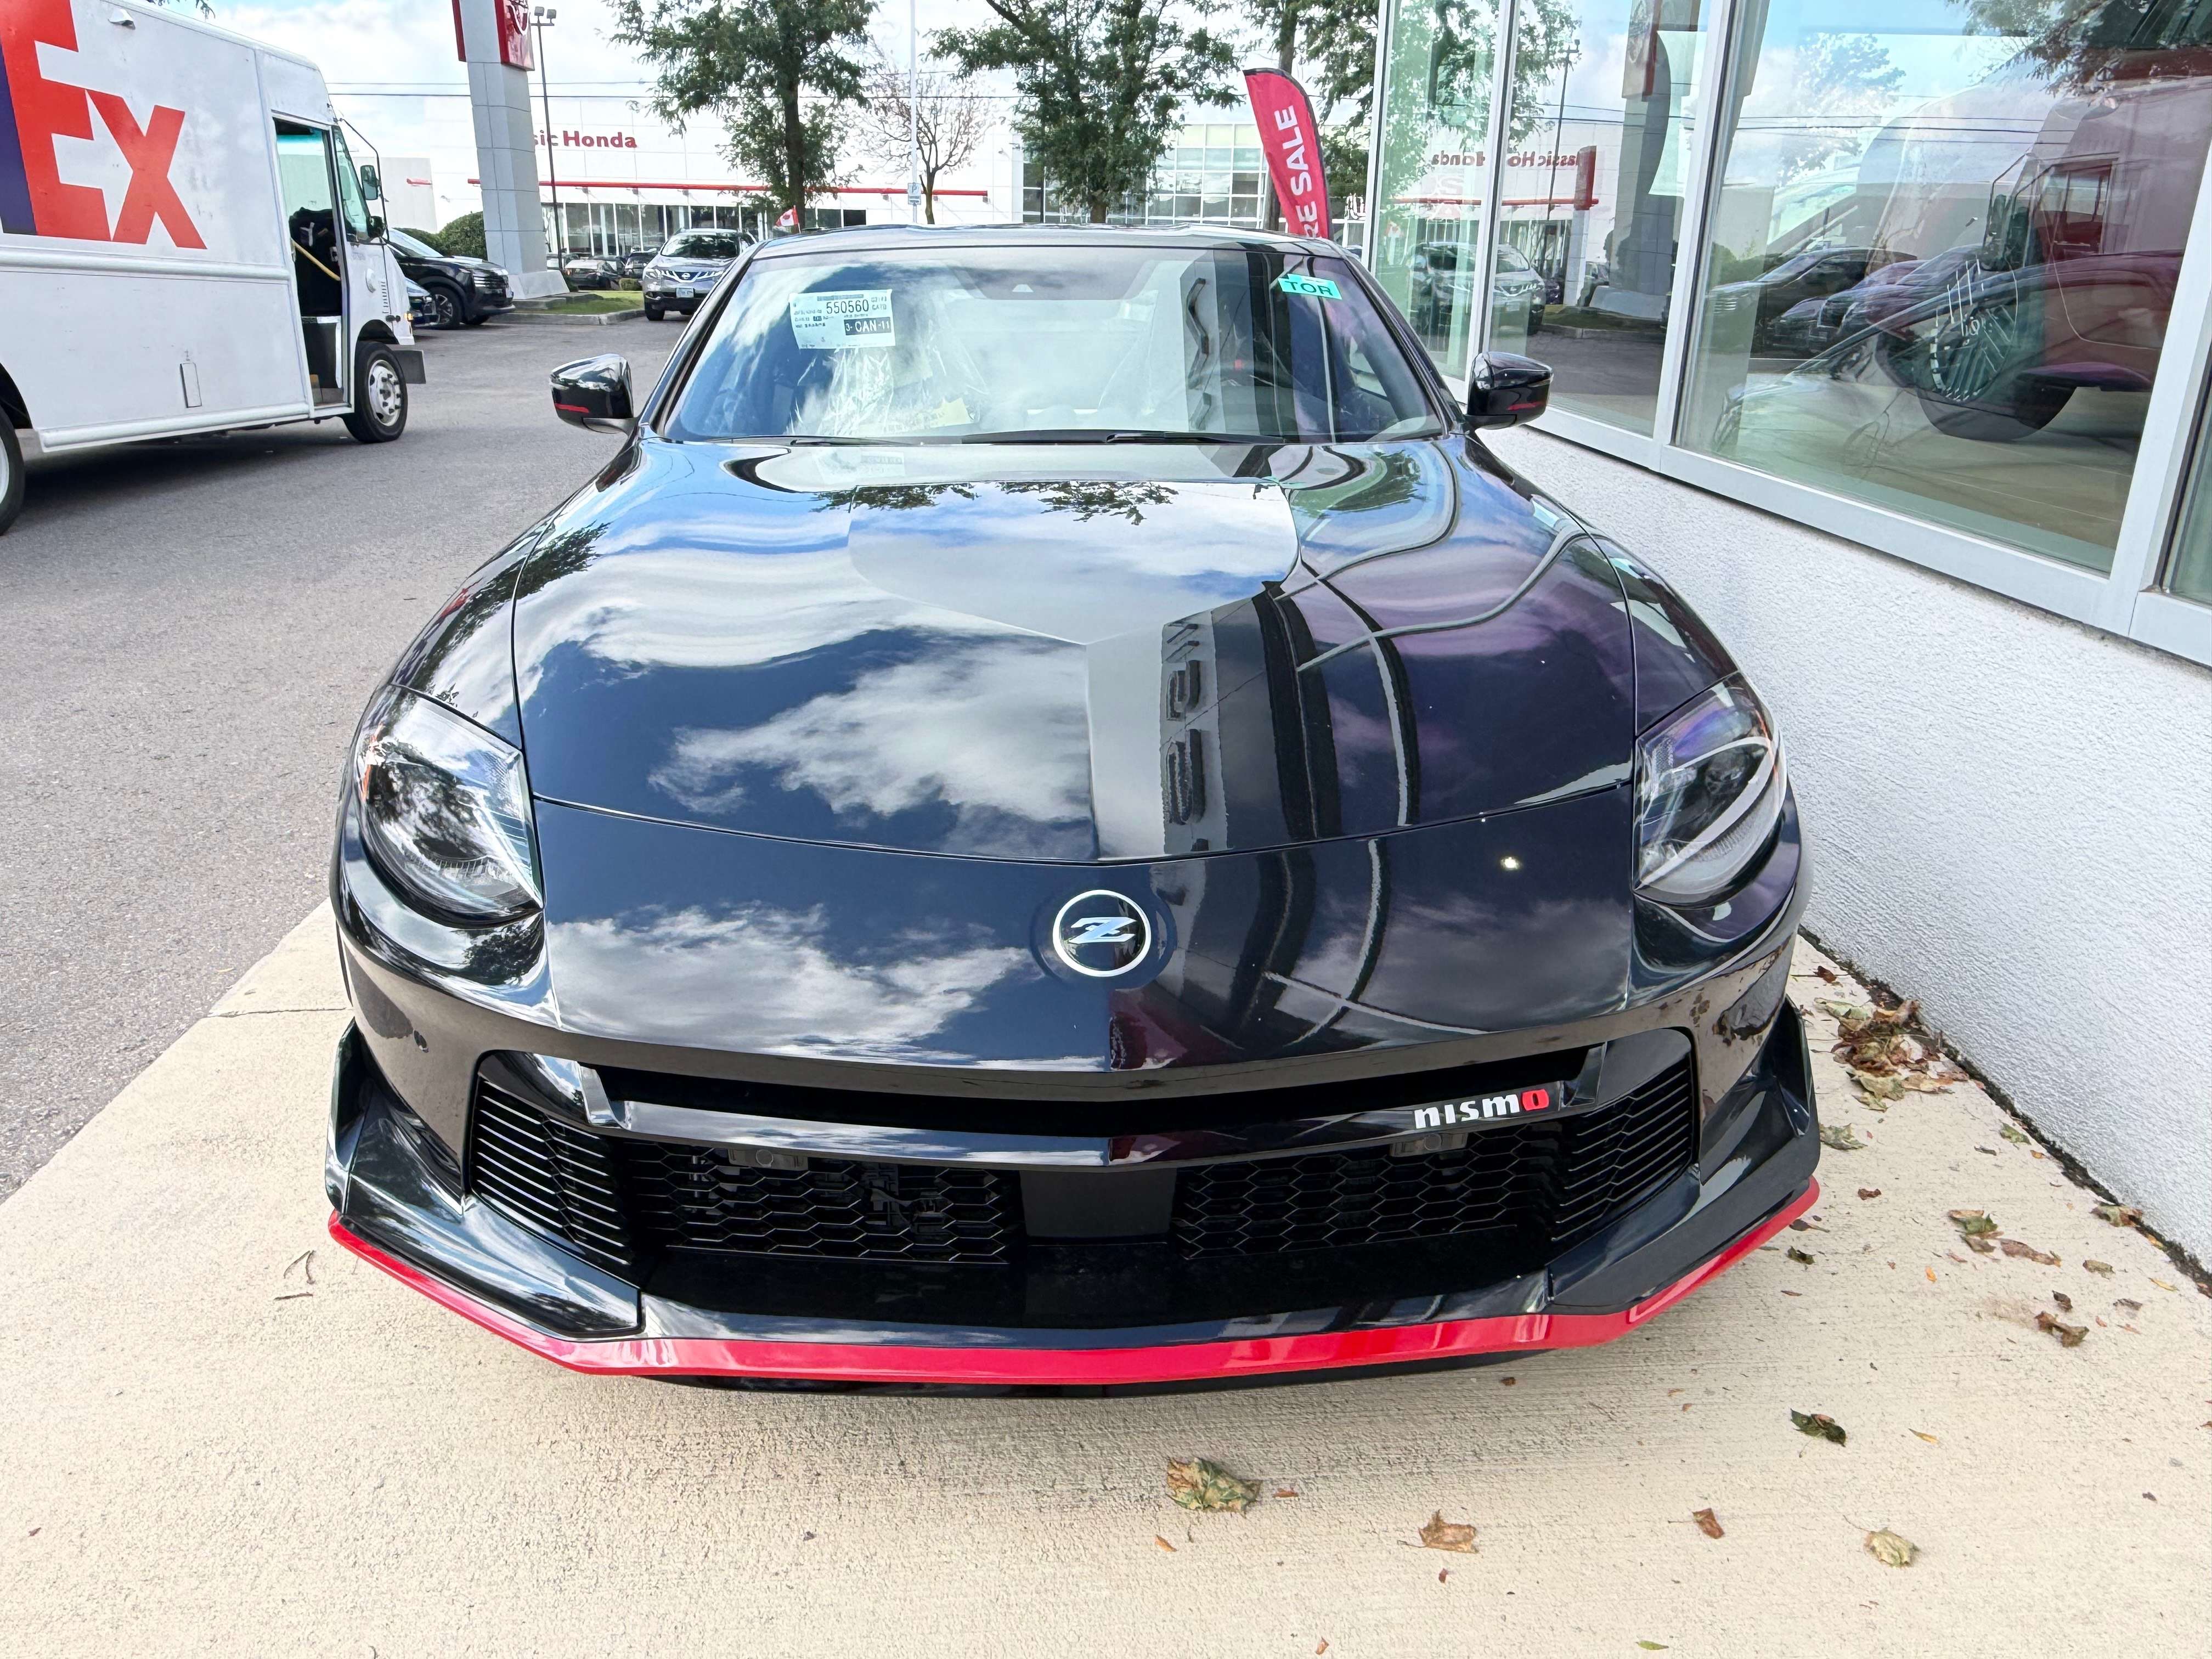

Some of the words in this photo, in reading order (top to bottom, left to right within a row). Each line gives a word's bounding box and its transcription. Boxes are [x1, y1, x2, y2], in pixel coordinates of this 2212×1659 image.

[0, 0, 207, 250] Ex
[563, 131, 637, 148] Honda
[1274, 105, 1312, 196] SALE
[1284, 280, 1334, 296] TOR
[826, 299, 869, 314] 550560
[1414, 1088, 1550, 1129] nismo
